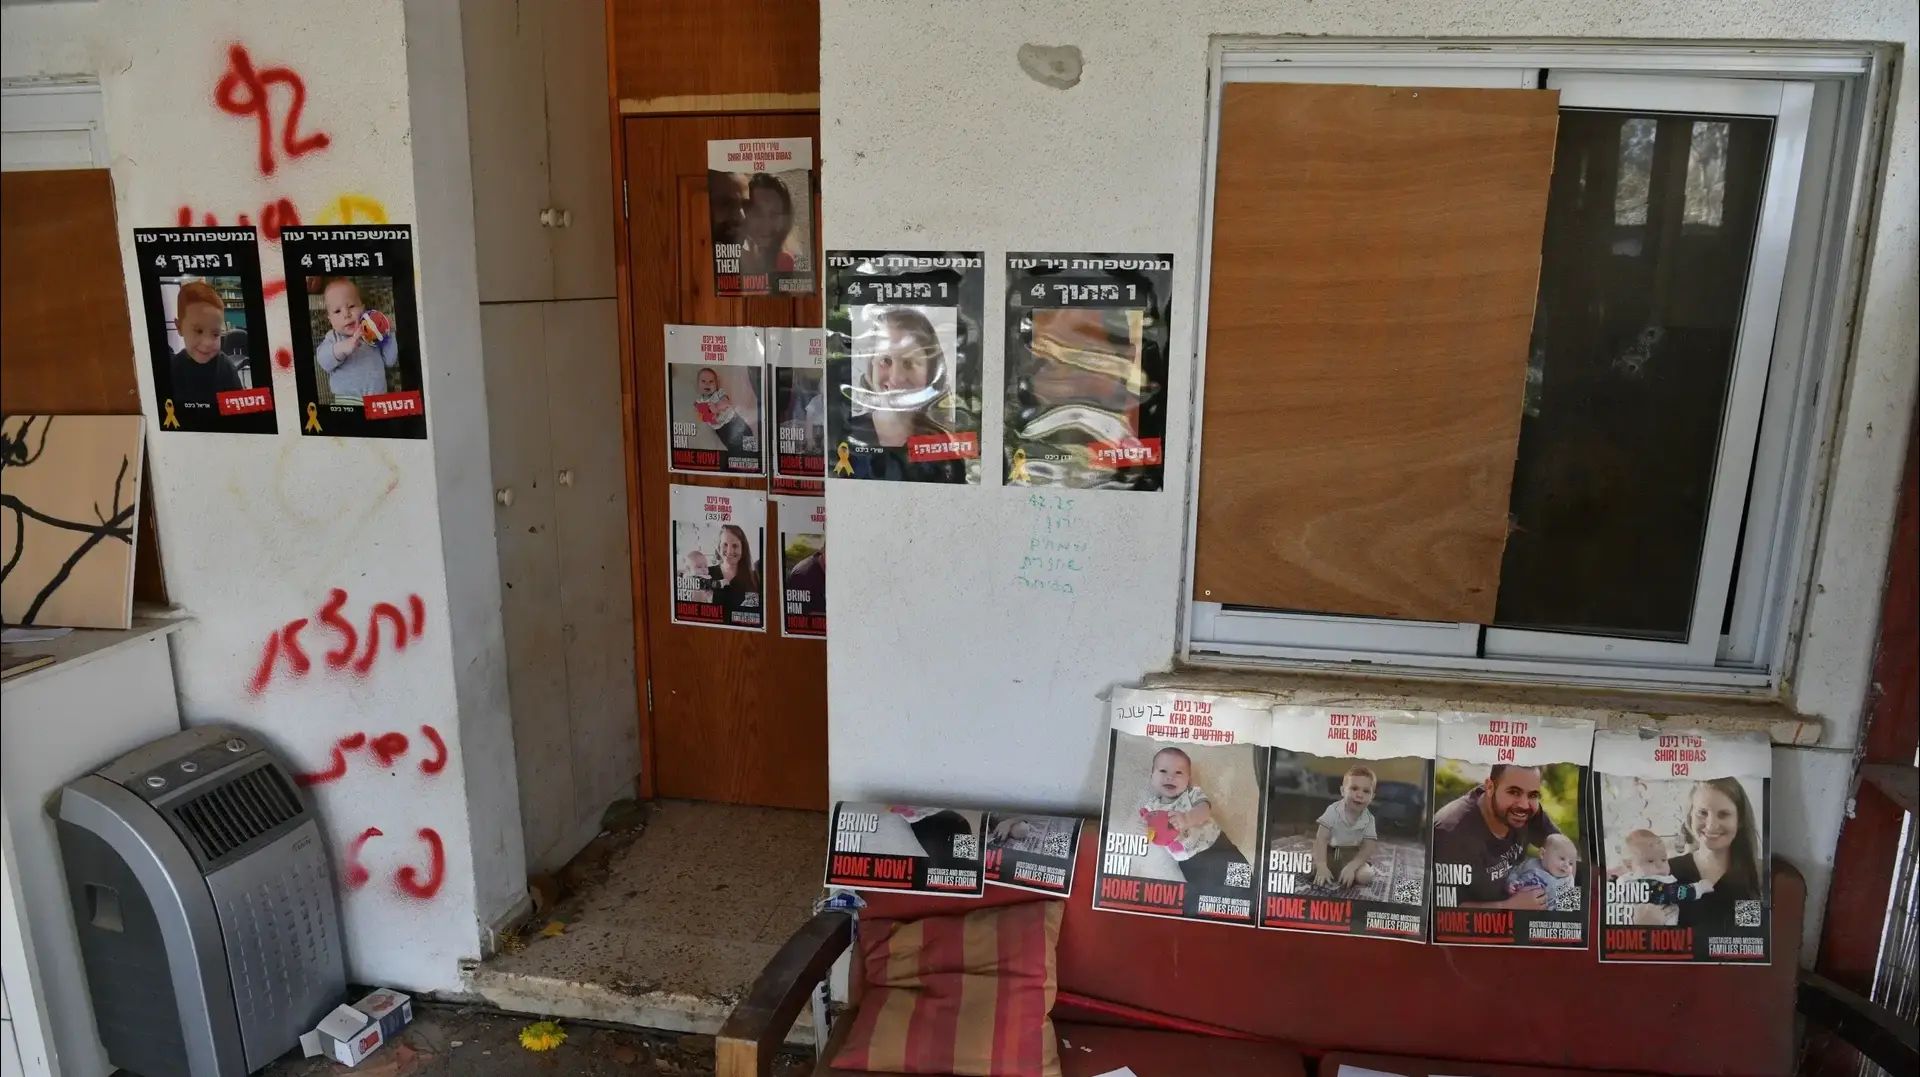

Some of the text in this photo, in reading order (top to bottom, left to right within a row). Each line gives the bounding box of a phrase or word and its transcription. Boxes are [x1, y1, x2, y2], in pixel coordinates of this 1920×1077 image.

[754, 152, 774, 160] YARDEN
[136, 232, 255, 243] ממשפחת ניר עוז
[283, 230, 410, 241] ממשפחת ניר עוז
[715, 244, 741, 259] BRING
[155, 253, 233, 272] 1 מתוך 4
[301, 252, 383, 272] 1 מתוך 4
[716, 259, 740, 273] THEM
[828, 256, 982, 268] ממשפחת ניר עוז
[1009, 258, 1170, 271] ממשפחת ניר עוז
[848, 282, 947, 302] 1 מתוך 4
[1030, 283, 1136, 304] 1 מתוך 4
[673, 422, 697, 436] BRING
[780, 428, 804, 441] BRING
[674, 436, 688, 449] HIM
[780, 441, 796, 454] HIM
[804, 456, 824, 470] NOW
[677, 576, 701, 590] BRING
[677, 589, 693, 601] HER
[787, 589, 811, 602] BRING
[787, 602, 802, 614] HIM
[812, 617, 826, 629] NO
[1169, 713, 1213, 727] KFIR BIBAS
[1328, 728, 1377, 741] ARIEL BIBAS
[1478, 734, 1536, 748] YARDEN BIBAS
[1346, 741, 1357, 755] (4)
[1498, 748, 1515, 762] (34)
[1655, 749, 1706, 762] SHIRI BIBAS
[1672, 763, 1689, 776] (32)
[837, 811, 878, 833] BRING
[835, 832, 862, 853] HIM
[1106, 832, 1148, 857] BRING
[833, 855, 913, 880] HOME NOW!
[1104, 853, 1131, 876] HIM
[1269, 850, 1312, 874] BRING
[927, 874, 977, 887] FAMILIES FORUM
[1014, 868, 1065, 885] FAMILIES FORUM
[1436, 863, 1472, 885] BRING
[1268, 873, 1295, 894] HIM
[1102, 878, 1185, 906] HOME NOW!
[1436, 886, 1457, 907] HIM
[1606, 882, 1649, 903] BRING
[1198, 902, 1249, 916] FAMILIES FORUM
[1267, 896, 1352, 922] HOME NOW!
[1606, 904, 1634, 925] HER
[1367, 918, 1419, 932] FAMILIES FORUM
[1437, 911, 1514, 934] HOME NOW!
[1529, 928, 1581, 939] FAMILIES FORUM
[1605, 927, 1693, 950] HOME NOW!
[1709, 944, 1763, 956] FAMILIES FORUM
